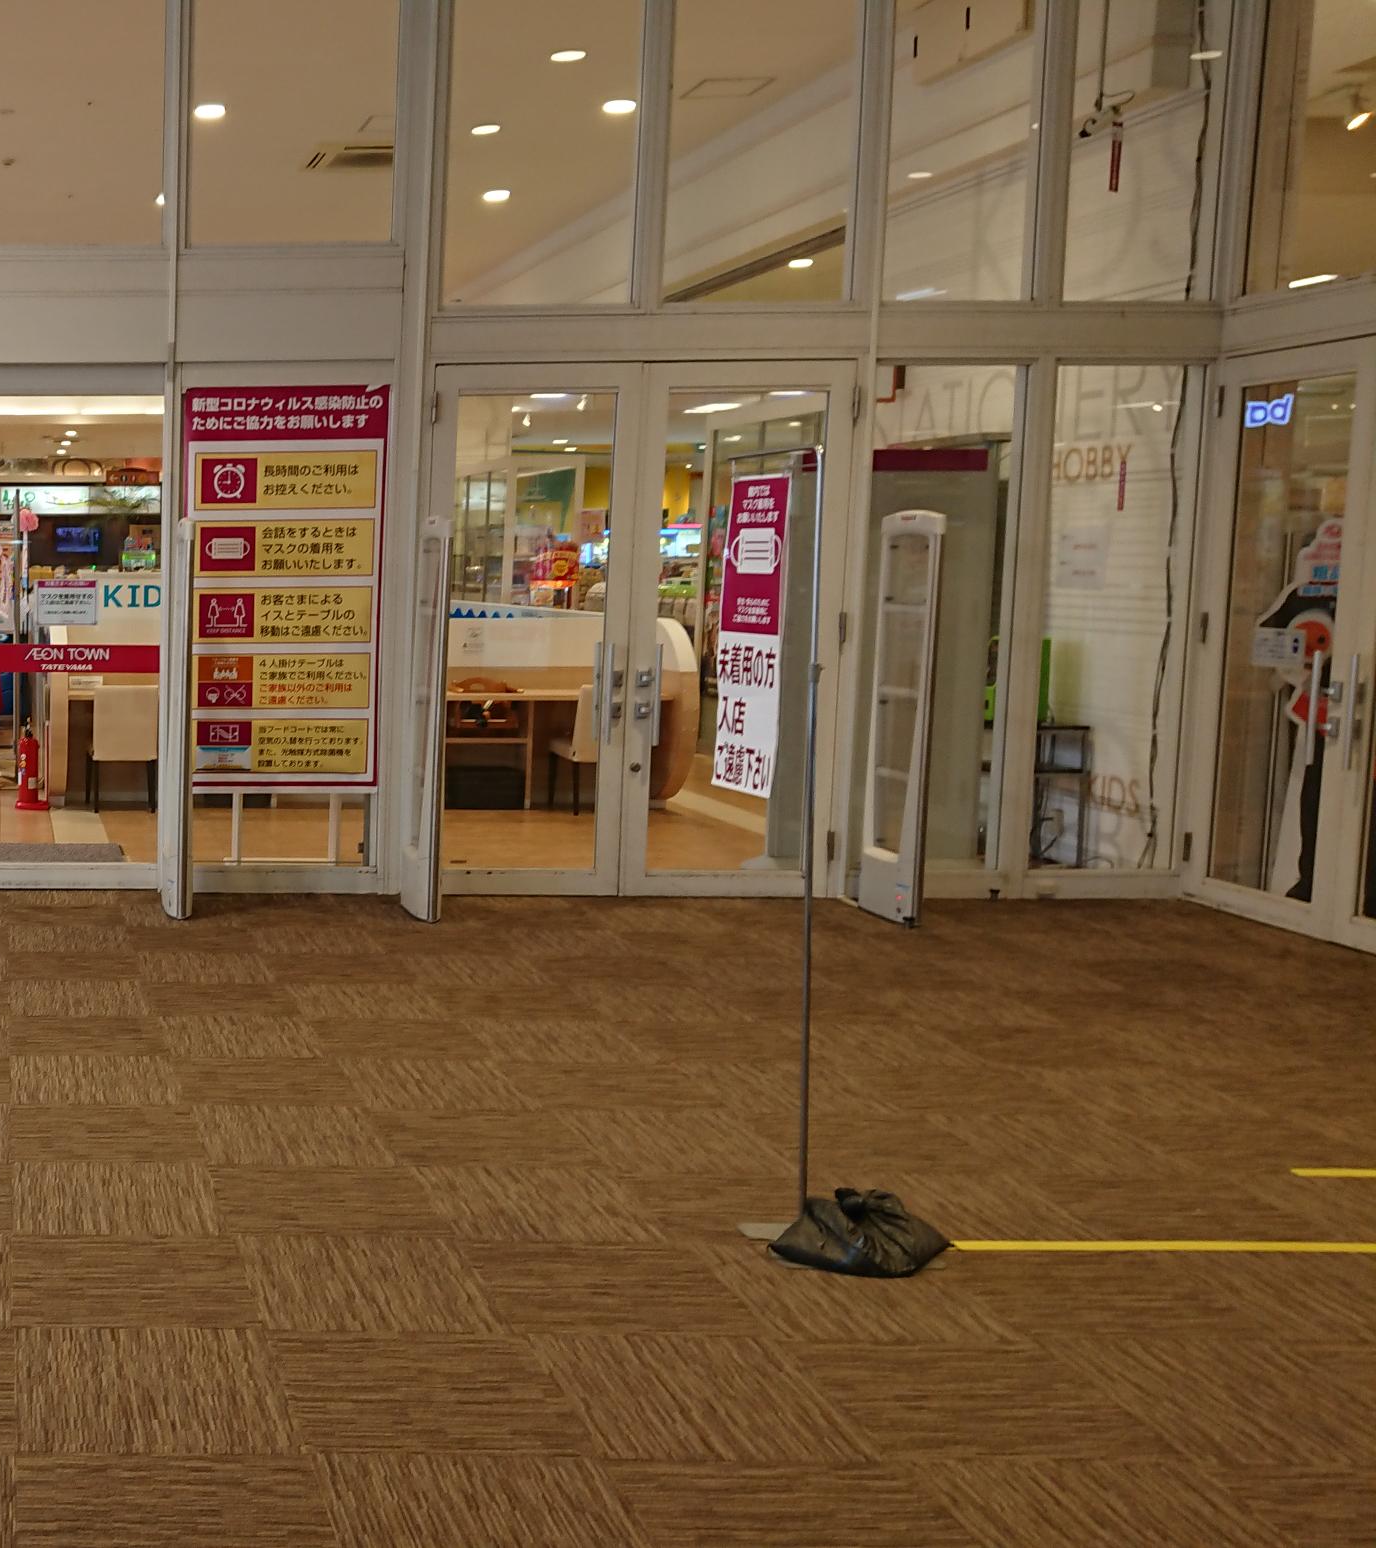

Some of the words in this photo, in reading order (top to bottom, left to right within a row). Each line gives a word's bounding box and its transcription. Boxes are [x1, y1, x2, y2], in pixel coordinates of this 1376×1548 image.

[191, 395, 384, 413] 新型コロナウィルス感染防止の
[191, 413, 369, 431] ためにご協力をお願いします
[263, 463, 360, 478] 長時間のご利用は
[263, 482, 353, 496] お控えください。
[261, 526, 357, 540] 会話をするときは
[261, 543, 345, 555] マスクの着用を
[261, 558, 362, 571] お願いいたします。
[260, 593, 344, 606] お客さまによる
[260, 609, 356, 622] イスとテーブルの
[259, 625, 368, 638] 移動はご遠慮ください。
[67, 647, 110, 661] TOWN
[40, 663, 93, 671] TATEYAMA
[718, 643, 777, 689] 未着用の方
[258, 671, 367, 681] ご家族でご利用ください。
[258, 683, 353, 694] ご家族以外のご利用は
[718, 695, 747, 736] 入店
[715, 743, 771, 791] ご遠慮下さい
